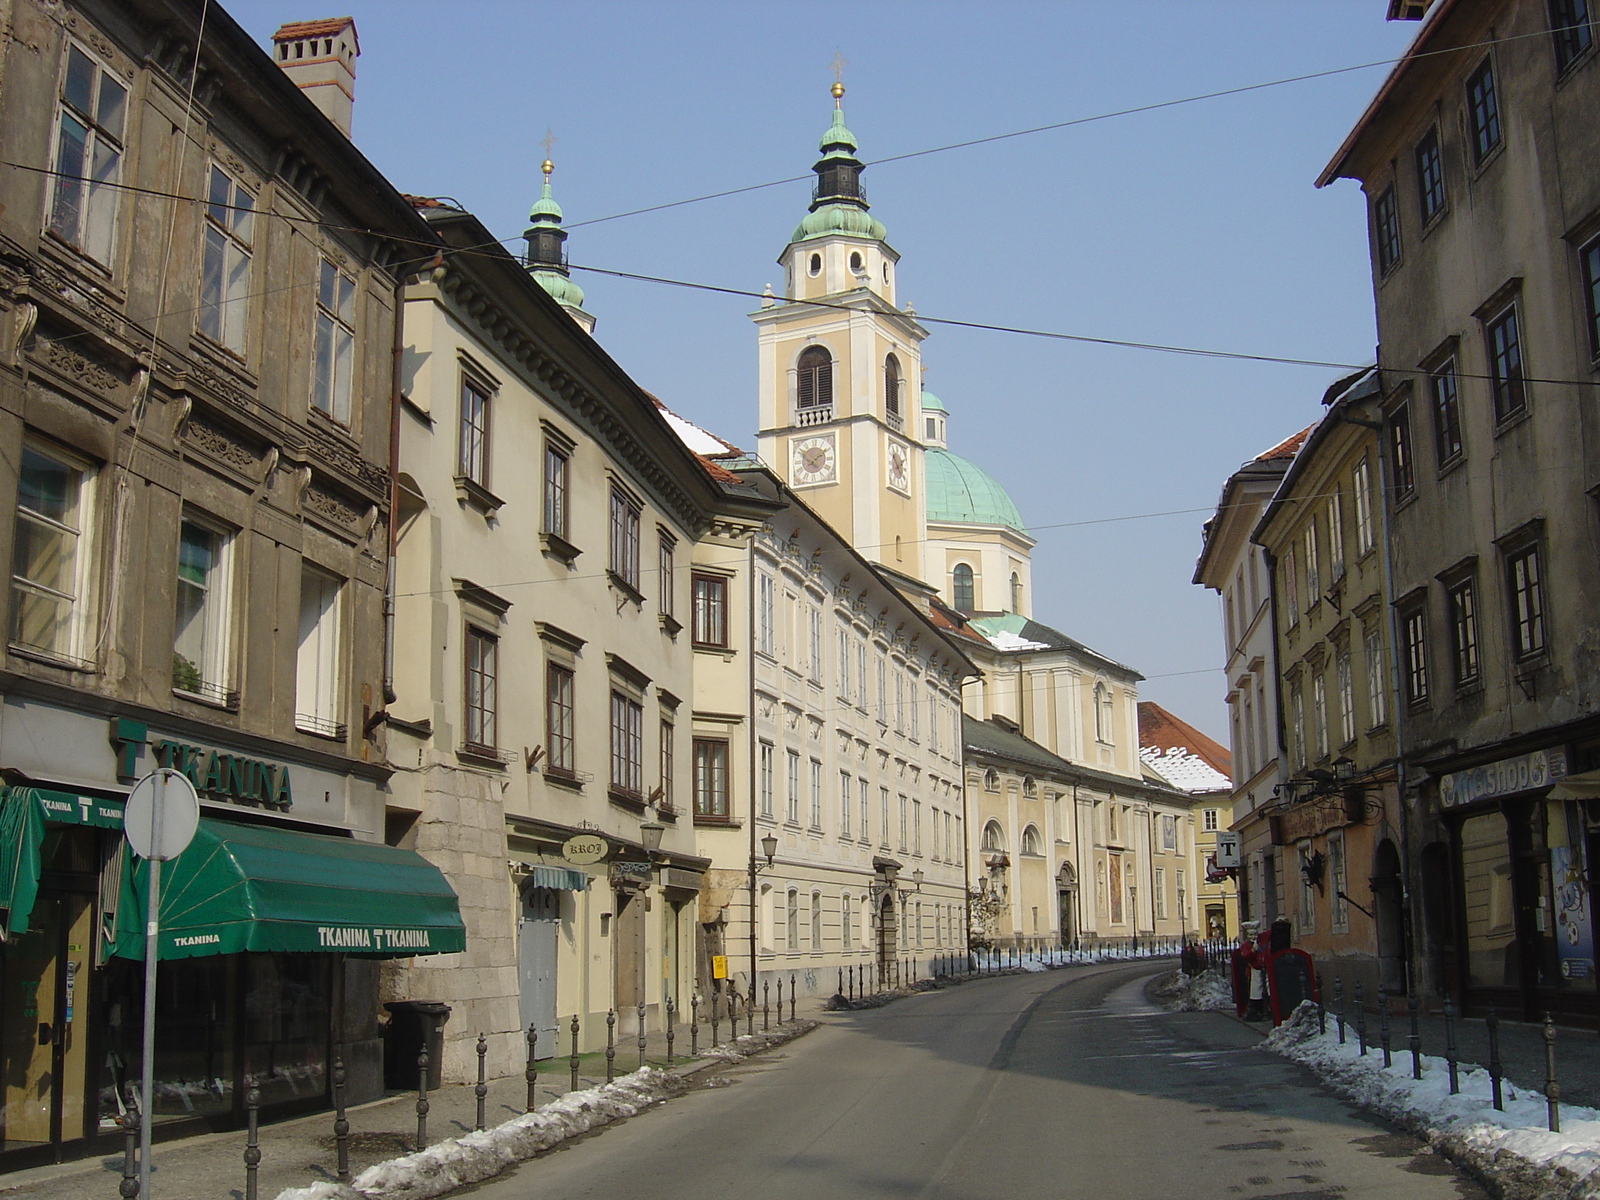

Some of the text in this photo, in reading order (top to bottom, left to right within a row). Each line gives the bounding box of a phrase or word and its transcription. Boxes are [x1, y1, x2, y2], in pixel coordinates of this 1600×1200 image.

[159, 739, 293, 805] TKANINA
[42, 799, 72, 812] TKANINA
[98, 807, 123, 819] TKANIN
[569, 843, 602, 855] KROJ
[1220, 842, 1236, 856] T
[173, 934, 220, 947] TKANINA
[318, 926, 371, 947] TKANINA
[385, 929, 430, 947] TKANINA
